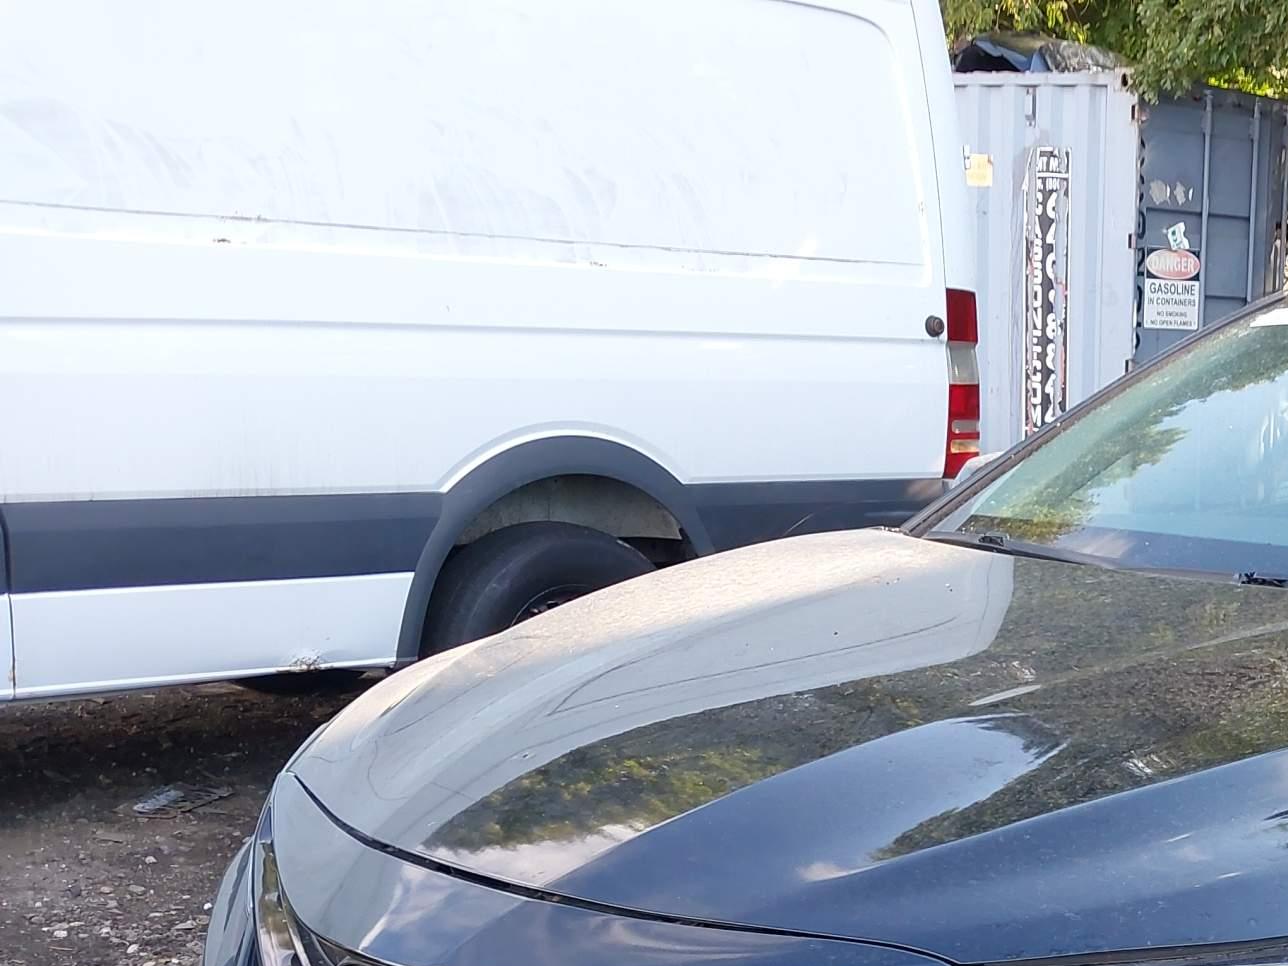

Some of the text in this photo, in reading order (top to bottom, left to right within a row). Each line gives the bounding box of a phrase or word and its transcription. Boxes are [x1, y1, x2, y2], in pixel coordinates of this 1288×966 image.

[1151, 256, 1195, 273] DANGER
[1149, 282, 1196, 296] GASOLINE
[1147, 296, 1196, 307] IN CONTAINERS
[1174, 320, 1192, 328] FLAMES
